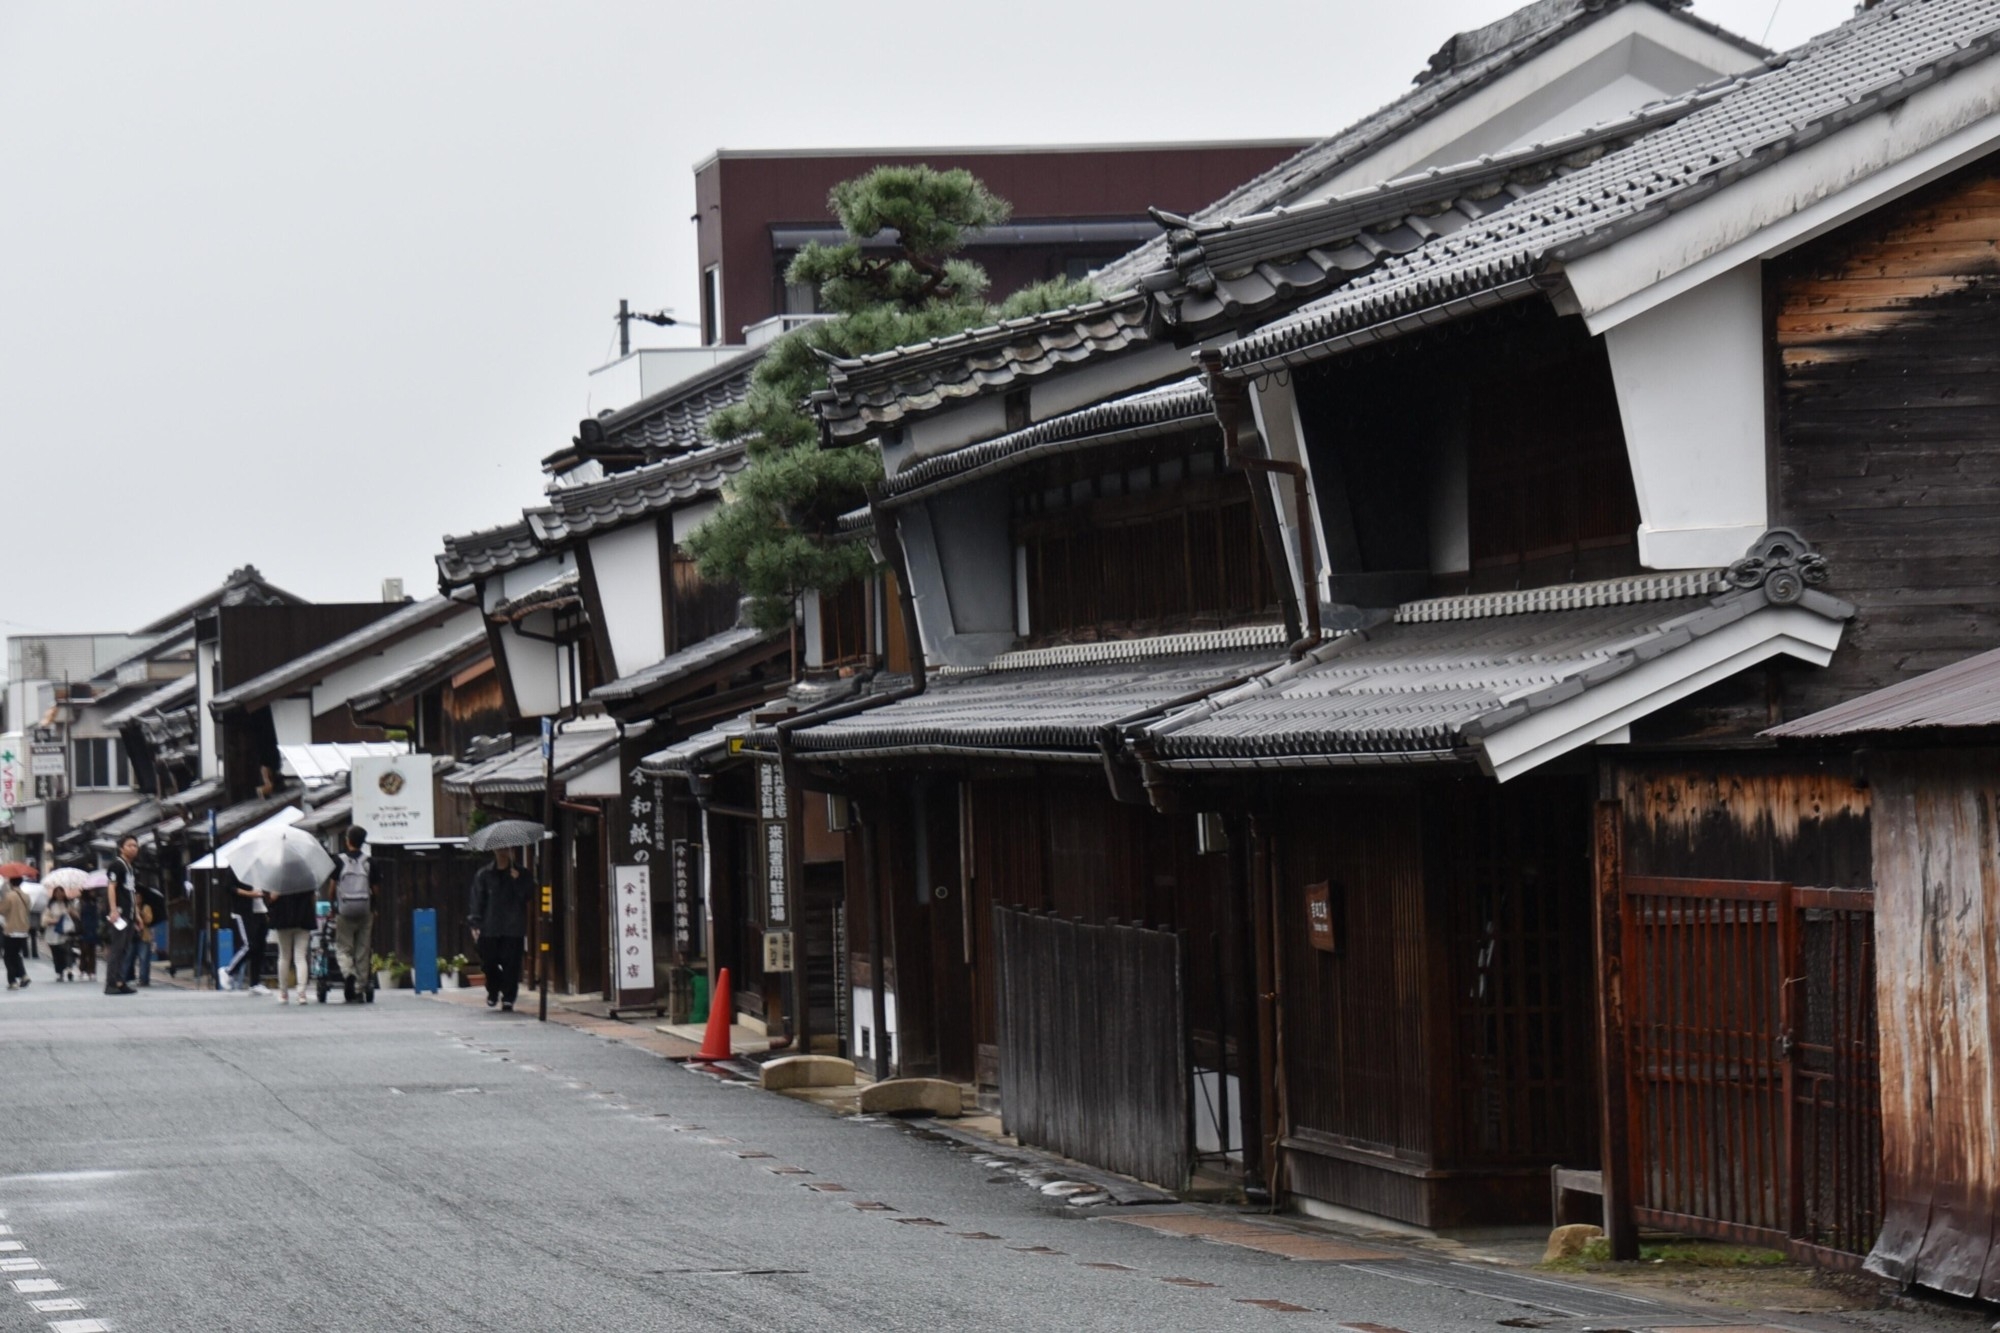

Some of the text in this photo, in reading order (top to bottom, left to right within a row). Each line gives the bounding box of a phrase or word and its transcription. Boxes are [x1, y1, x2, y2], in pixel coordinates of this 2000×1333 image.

[768, 824, 786, 921] 来館者用駐車場
